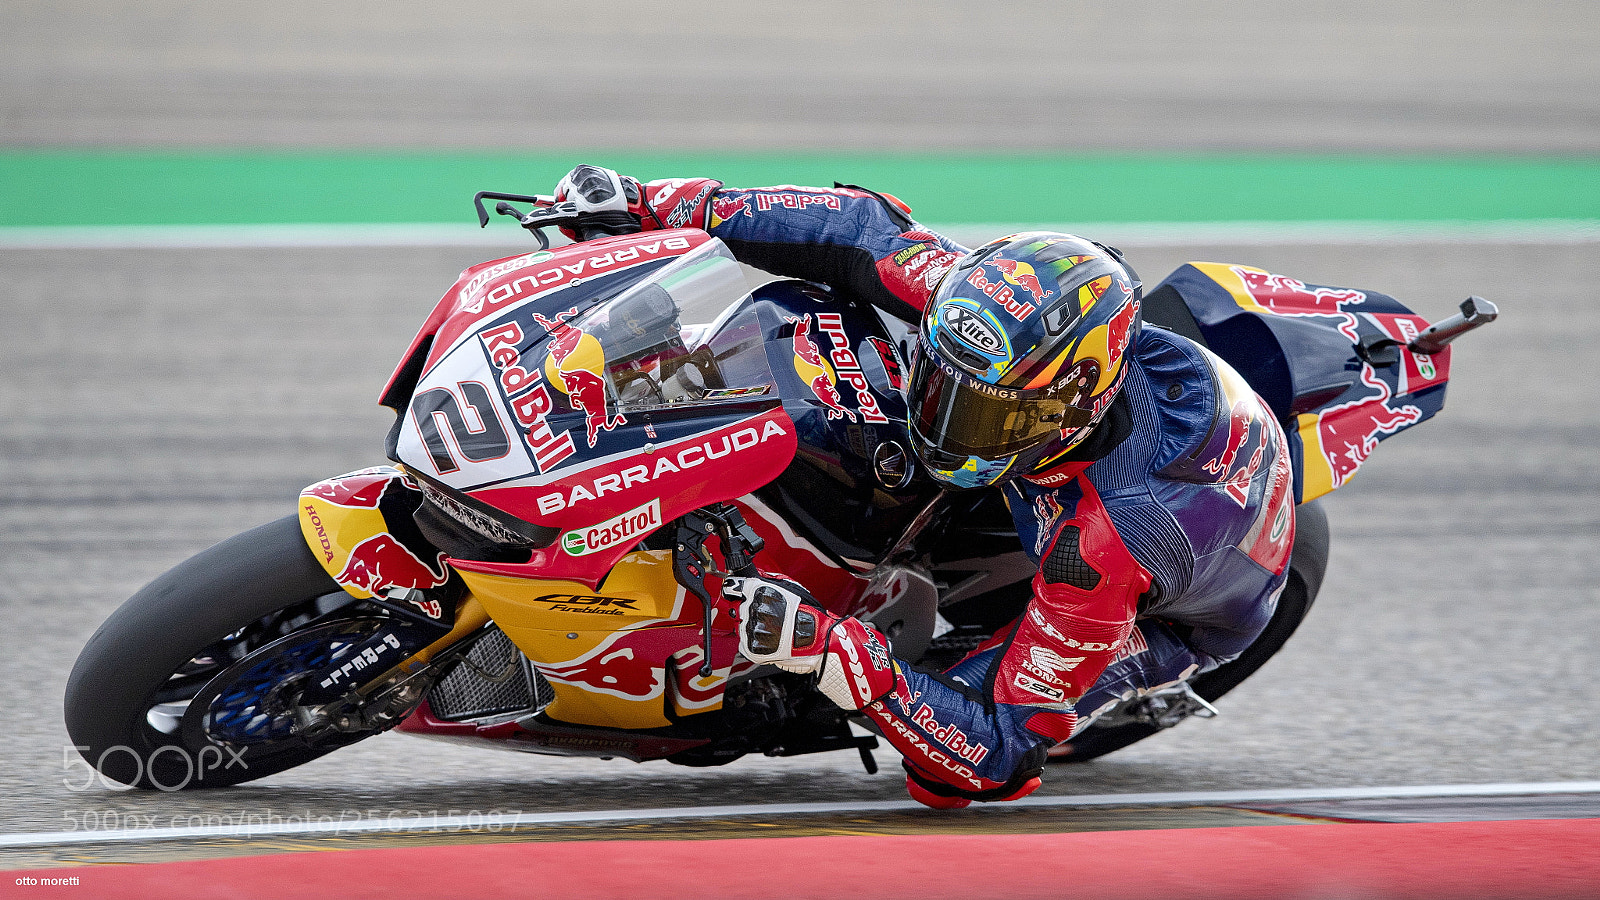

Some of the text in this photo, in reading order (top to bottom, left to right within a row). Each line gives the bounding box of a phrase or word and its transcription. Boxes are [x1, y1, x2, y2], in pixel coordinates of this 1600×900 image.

[463, 237, 690, 314] BARRACUDA
[464, 258, 528, 300] Castrol
[949, 307, 995, 351] X-lite
[940, 360, 963, 381] YOU
[969, 378, 1018, 400] WINGS
[411, 380, 511, 475] 2
[536, 420, 787, 516] BARRACUDA
[305, 505, 334, 565] HONDA
[586, 504, 658, 550] Castrol
[533, 594, 640, 611] CBR
[549, 604, 625, 616] Fireblade
[320, 633, 400, 689] PIRELLI
[869, 701, 982, 790] BARRACUDA
